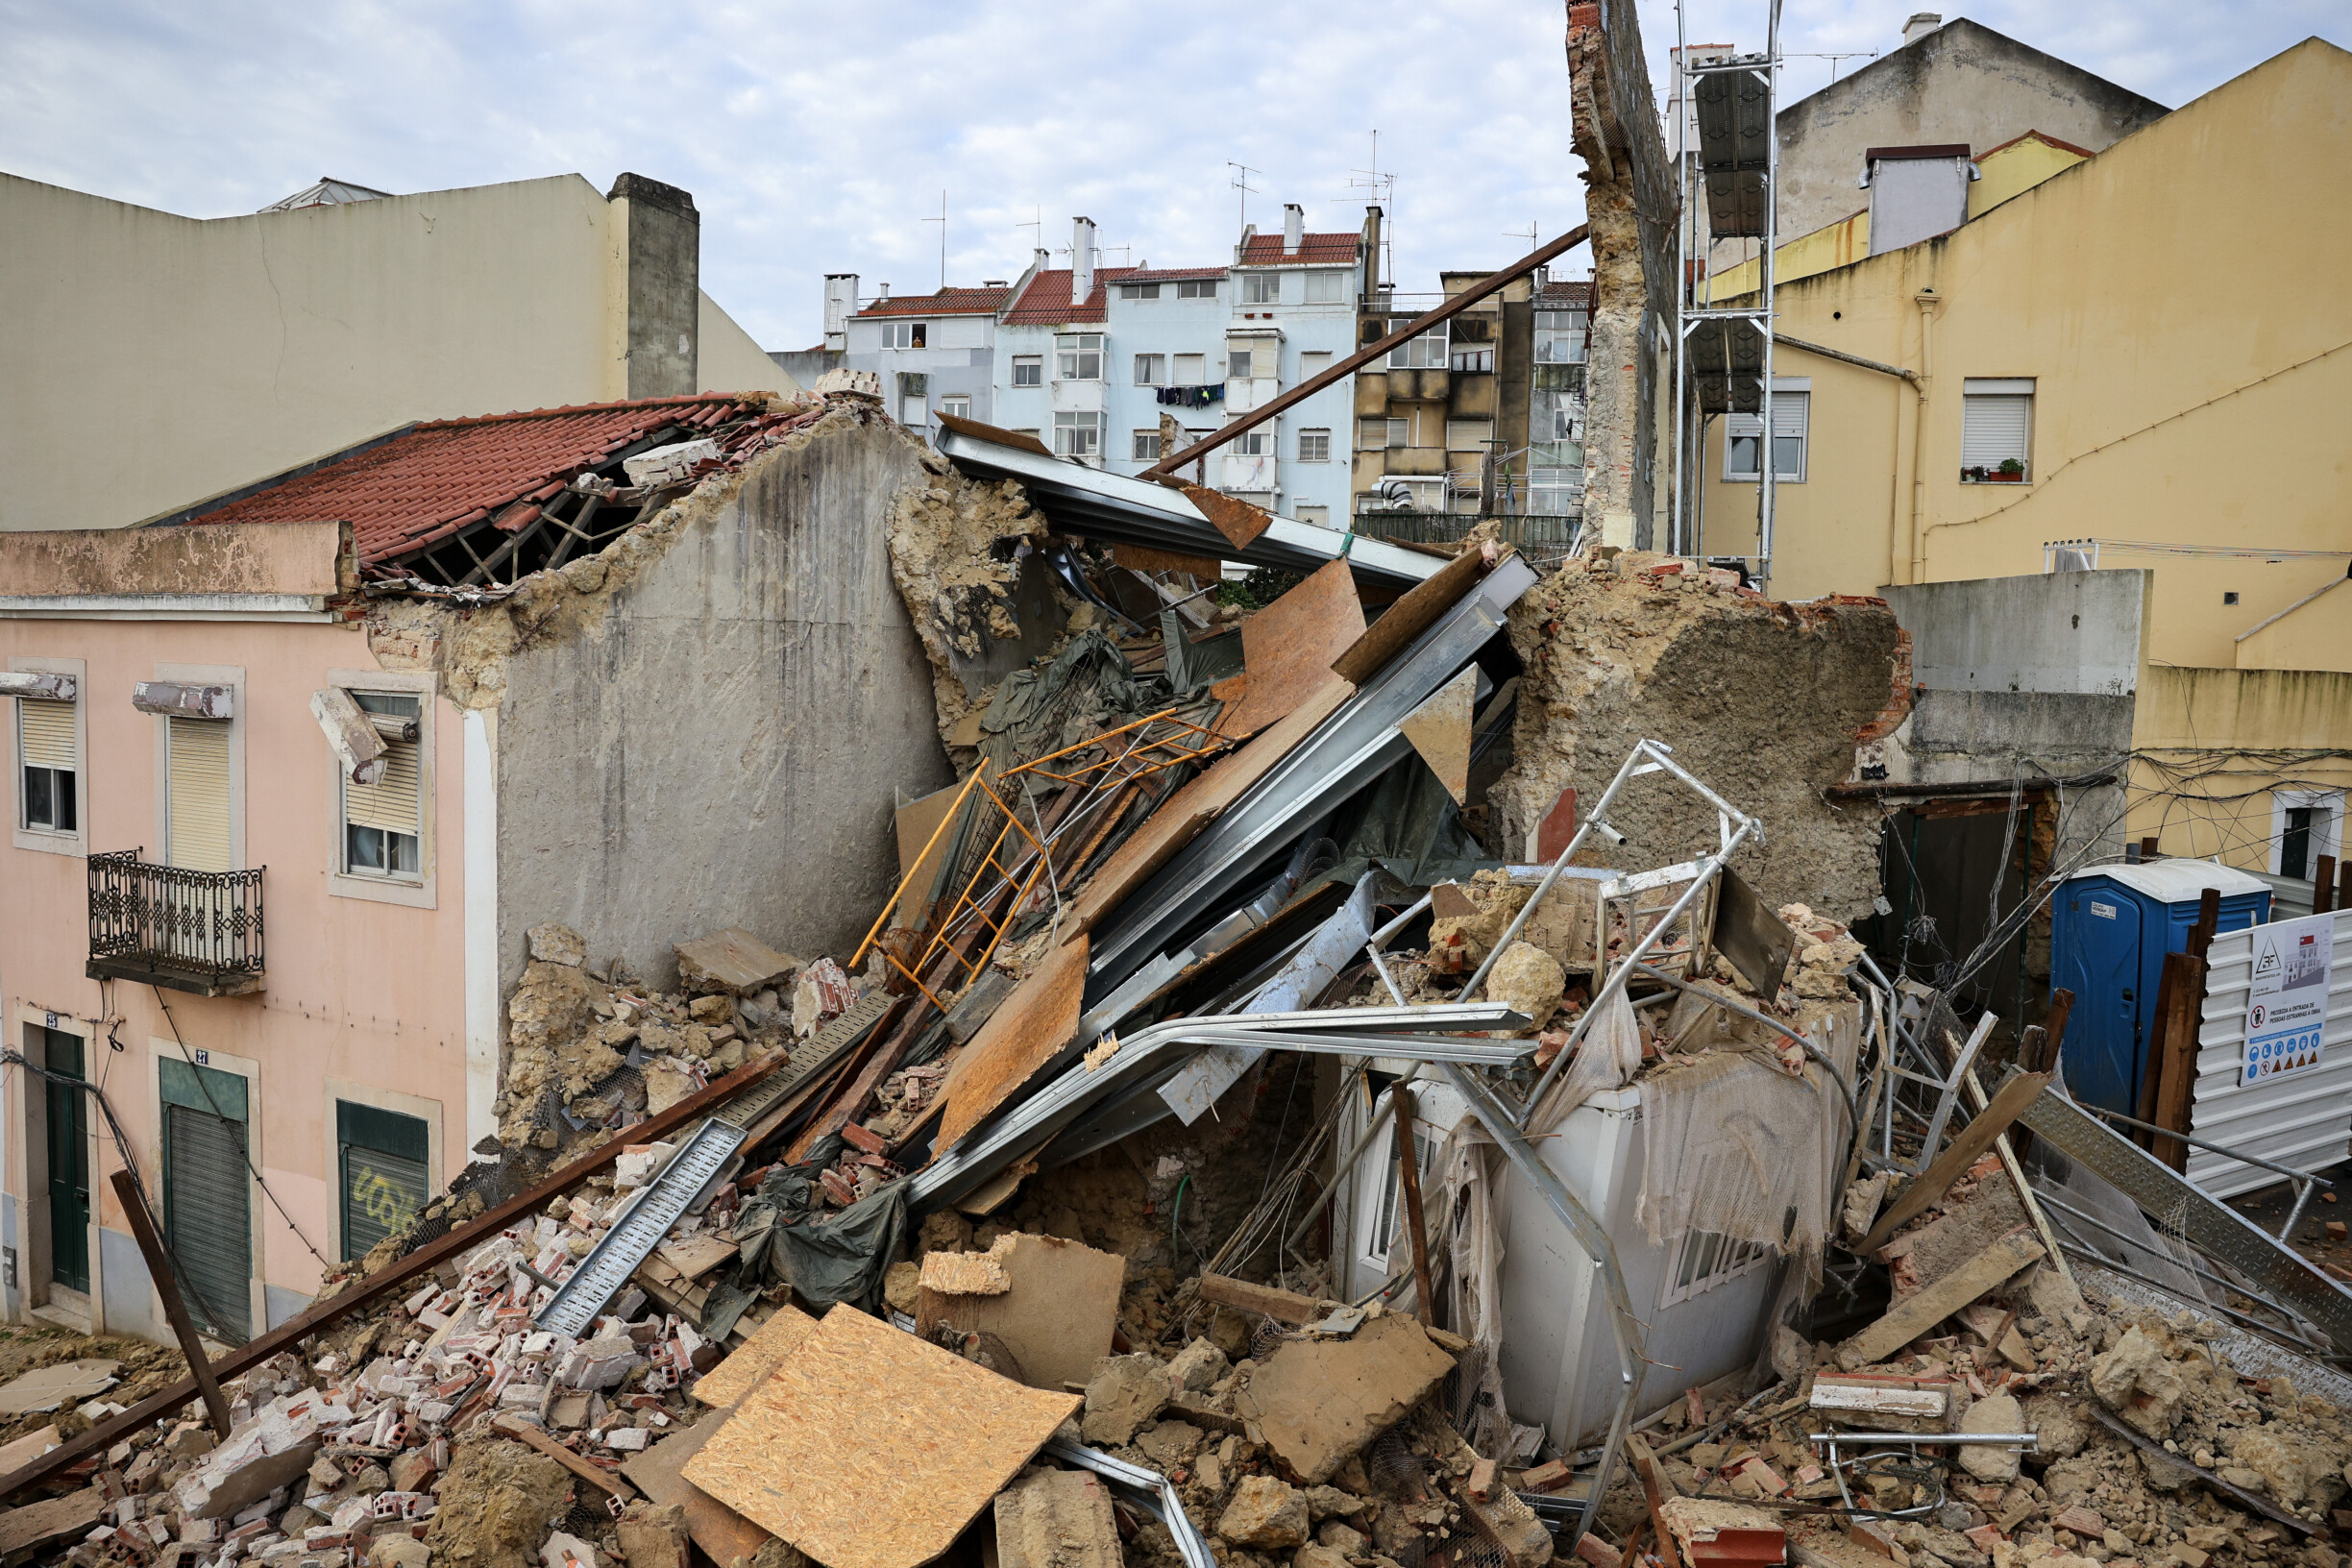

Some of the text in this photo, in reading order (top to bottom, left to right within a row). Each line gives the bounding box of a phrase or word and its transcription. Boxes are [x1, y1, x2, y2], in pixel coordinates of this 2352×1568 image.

[2270, 1008, 2289, 1017] PROIBIDA
[2292, 1003, 2309, 1012] ENTRADA
[47, 1015, 56, 1027] 25
[2269, 1016, 2286, 1024] PESSOAS
[2287, 1011, 2307, 1020] ESTRANHAS
[197, 1050, 207, 1064] 27
